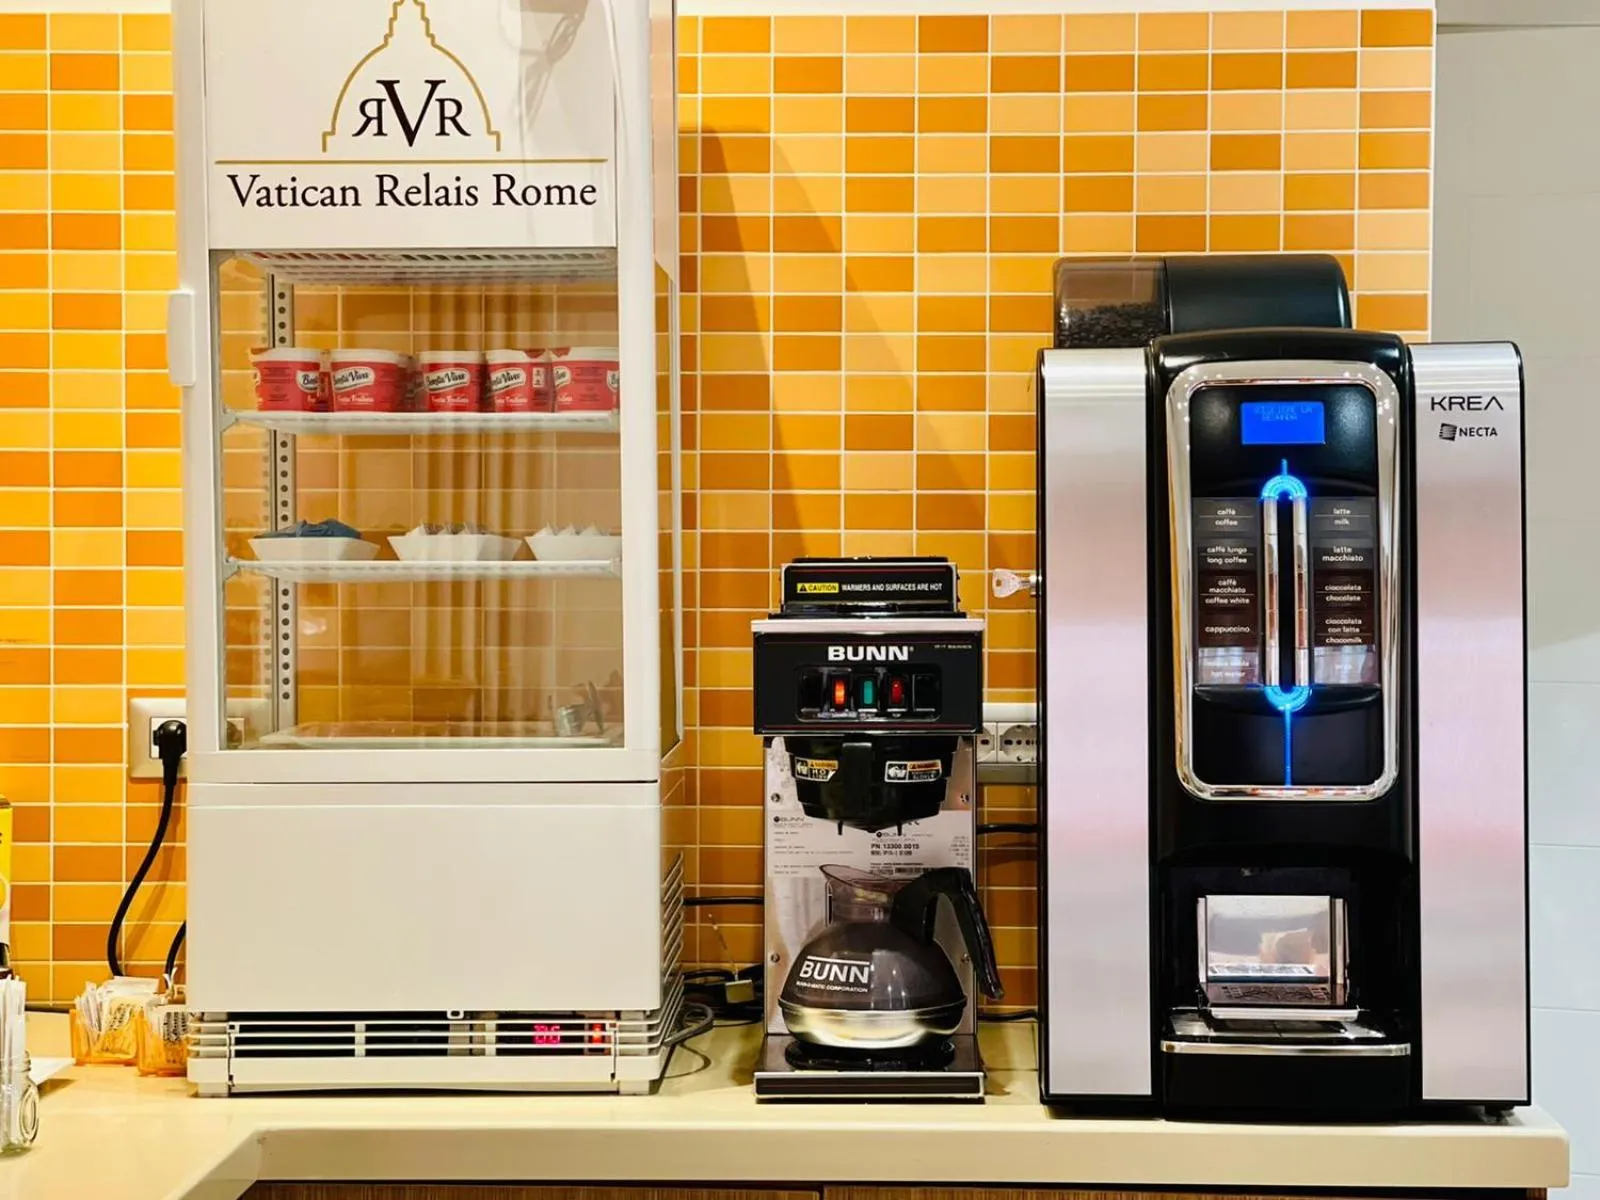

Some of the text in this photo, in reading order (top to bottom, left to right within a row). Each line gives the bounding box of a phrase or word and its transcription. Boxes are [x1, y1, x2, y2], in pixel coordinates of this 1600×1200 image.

[226, 173, 598, 208] Vatican Relais Rome
[1430, 396, 1504, 411] KREA
[1459, 427, 1498, 437] NECTA
[1333, 508, 1351, 516] latte
[1215, 518, 1238, 526] coffee
[1334, 518, 1350, 526] milk
[1227, 546, 1248, 555] lungo
[1206, 556, 1248, 565] long coffee
[1322, 554, 1364, 562] macchiato
[808, 582, 943, 592] CAUTION WARMERS AND SURFACES ARE HOT
[1209, 586, 1246, 594] macchiato
[1324, 584, 1362, 592] cioccolata
[1205, 596, 1250, 604] coffee white
[1326, 594, 1361, 602] chocolate
[1326, 618, 1362, 626] cioccolata
[1204, 625, 1250, 634] cappuccino
[1326, 636, 1362, 644] chocomilk
[800, 961, 870, 984] BUNN
[826, 984, 868, 993] CORPORATION
